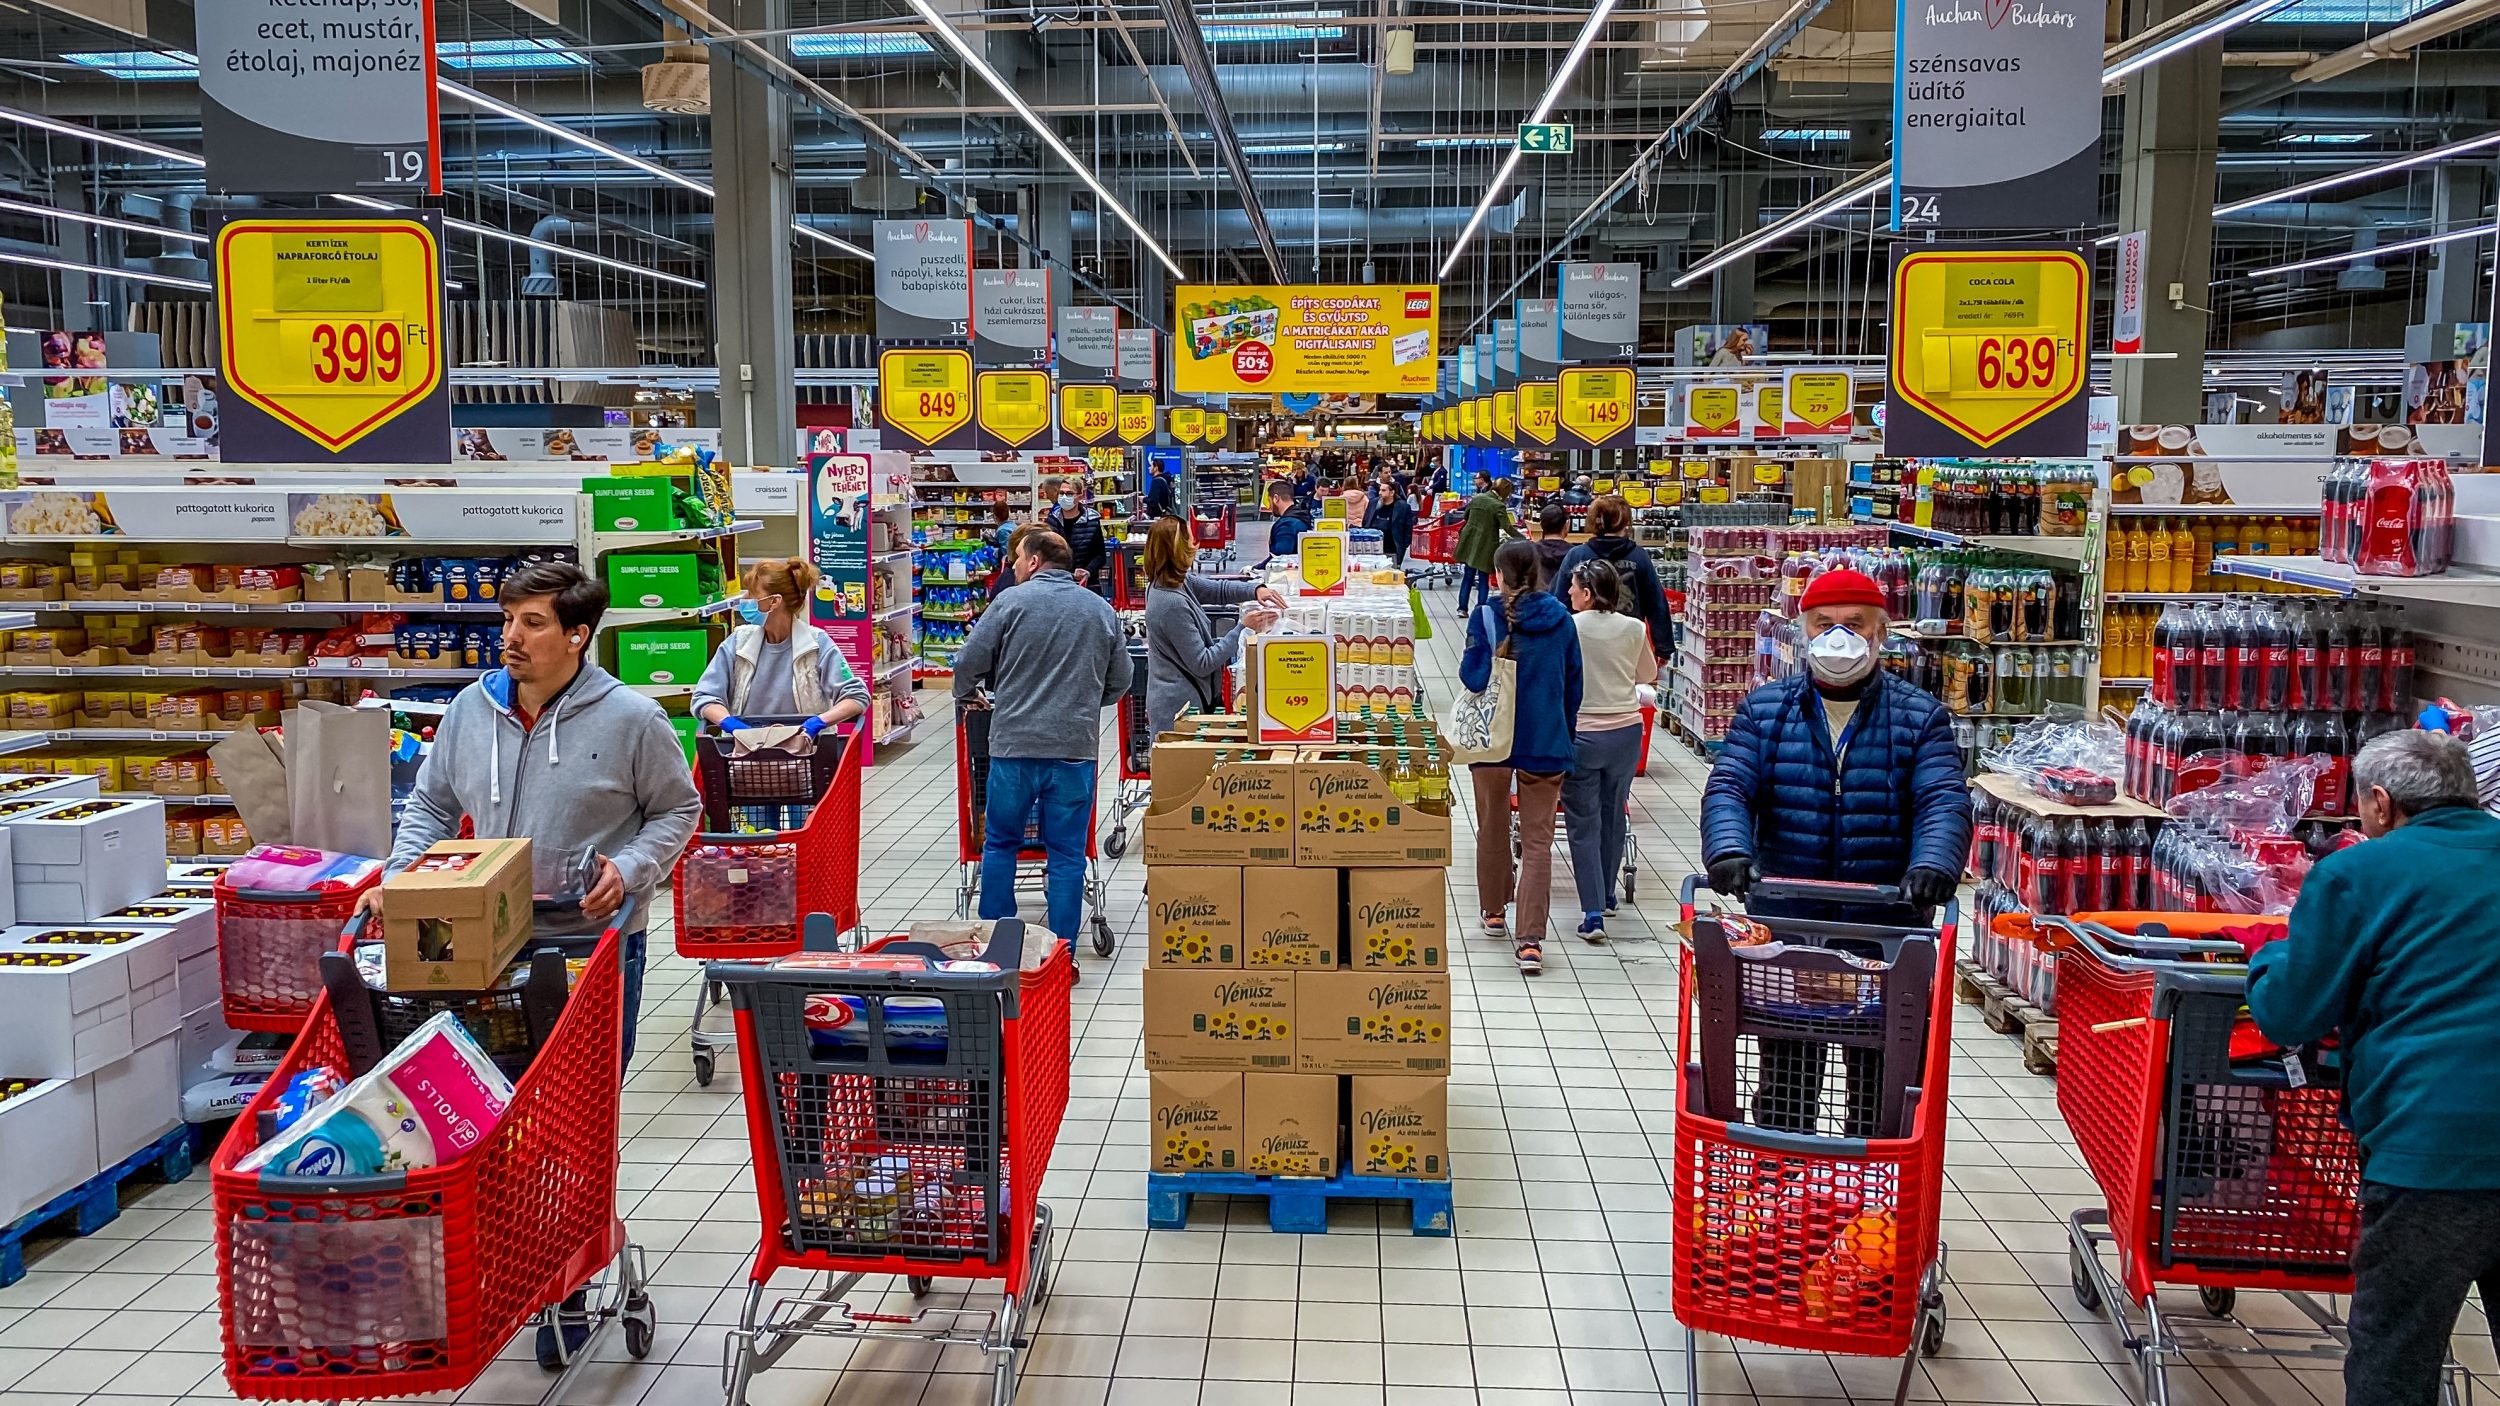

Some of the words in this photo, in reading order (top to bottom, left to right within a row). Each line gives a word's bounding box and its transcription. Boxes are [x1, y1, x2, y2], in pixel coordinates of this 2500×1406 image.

[1925, 0, 1982, 26] Auchan
[2011, 0, 2076, 28] Budaörs
[257, 18, 315, 43] ecet,
[323, 16, 420, 43] mustár,
[226, 49, 306, 78] étolaj,
[313, 49, 421, 78] majonéz
[1908, 54, 2020, 73] szénsavas
[1908, 80, 1965, 100] üdítő
[1907, 107, 2026, 132] energiaital
[383, 151, 423, 182] 19
[1901, 196, 1941, 223] 24
[887, 229, 914, 242] Auchan
[306, 240, 329, 248] KERTI
[330, 239, 348, 248] ÍZEK
[277, 252, 342, 261] NAPRAFORGÓ
[343, 251, 378, 261] ÉTOLAJ
[920, 254, 967, 266] puszedli,
[891, 268, 933, 280] nápolyi,
[935, 268, 967, 278] keksz,
[2123, 237, 2132, 315] VONALKÓD
[2130, 239, 2139, 310] LEOLVASÓ
[902, 280, 967, 293] babapiskóta
[1969, 278, 1992, 286] COCA
[1993, 278, 2015, 286] COLA
[1000, 296, 1025, 306] cukor,
[1291, 295, 1320, 309] ÉPÍTS
[1321, 295, 1381, 310] CSODÁKAT,
[1406, 299, 1430, 311] LEGO
[1563, 301, 1589, 310] barna
[1591, 302, 1607, 311] sör,
[984, 306, 1002, 315] házi
[1303, 309, 1316, 322] ÉS
[1318, 309, 1369, 323] GYŰJTSD
[1563, 312, 1610, 322] különleges
[1612, 312, 1626, 320] sör
[986, 316, 1047, 325] zsemlemorzsa
[1520, 320, 1548, 328] alkohol
[950, 321, 968, 335] 15
[1282, 326, 1290, 336] A
[1291, 323, 1358, 337] MATRICÁKAT
[1359, 322, 1390, 336] AKÁR
[1295, 337, 1360, 350] DIGITÁLISAN
[1361, 338, 1376, 350] IS!
[312, 322, 402, 383] 399
[407, 324, 427, 345] Ft
[1033, 350, 1046, 360] 13
[1618, 345, 1634, 356] 18
[1237, 356, 1269, 369] 50%
[1977, 337, 2056, 389] 639
[2056, 338, 2075, 357] Ft
[1104, 368, 1113, 378] 11
[1401, 374, 1430, 382] Auchan
[919, 392, 956, 417] 849
[958, 392, 968, 402] Ft
[1809, 404, 1829, 413] 279
[1588, 402, 1618, 422] 149
[1705, 412, 1722, 420] 149
[1084, 412, 1108, 427] 239
[1121, 416, 1147, 430] 1395
[2256, 431, 2312, 440] alkoholmentes
[2313, 431, 2325, 440] sör
[827, 463, 864, 478] NYERJ
[845, 475, 857, 483] EGY
[634, 488, 654, 496] SEEDS
[832, 481, 867, 493] TEHENET
[176, 503, 232, 515] pattogatott
[234, 503, 275, 513] kukorica
[462, 505, 519, 517] pattogatott
[521, 505, 563, 515] kukorica
[2054, 500, 2074, 509] fuze
[252, 516, 275, 524] popcorn
[1315, 568, 1329, 576] 399
[669, 642, 690, 650] SEEDS
[1285, 695, 1309, 706] 499
[1212, 773, 1272, 799] Vénusz
[1309, 773, 1370, 799] Vénusz
[1155, 899, 1217, 925] Vénusz
[1358, 901, 1421, 928] Vénusz
[1262, 928, 1309, 948] Vénusz
[1214, 981, 1273, 1007] Vénusz
[1368, 984, 1428, 1009] Vénusz
[210, 1095, 237, 1107] Land
[417, 1079, 459, 1126] ROLLS
[1157, 1104, 1219, 1130] Vénusz
[1360, 1109, 1422, 1134] Vénusz
[459, 1127, 475, 1144] 16
[1262, 1135, 1309, 1154] Vénusz
